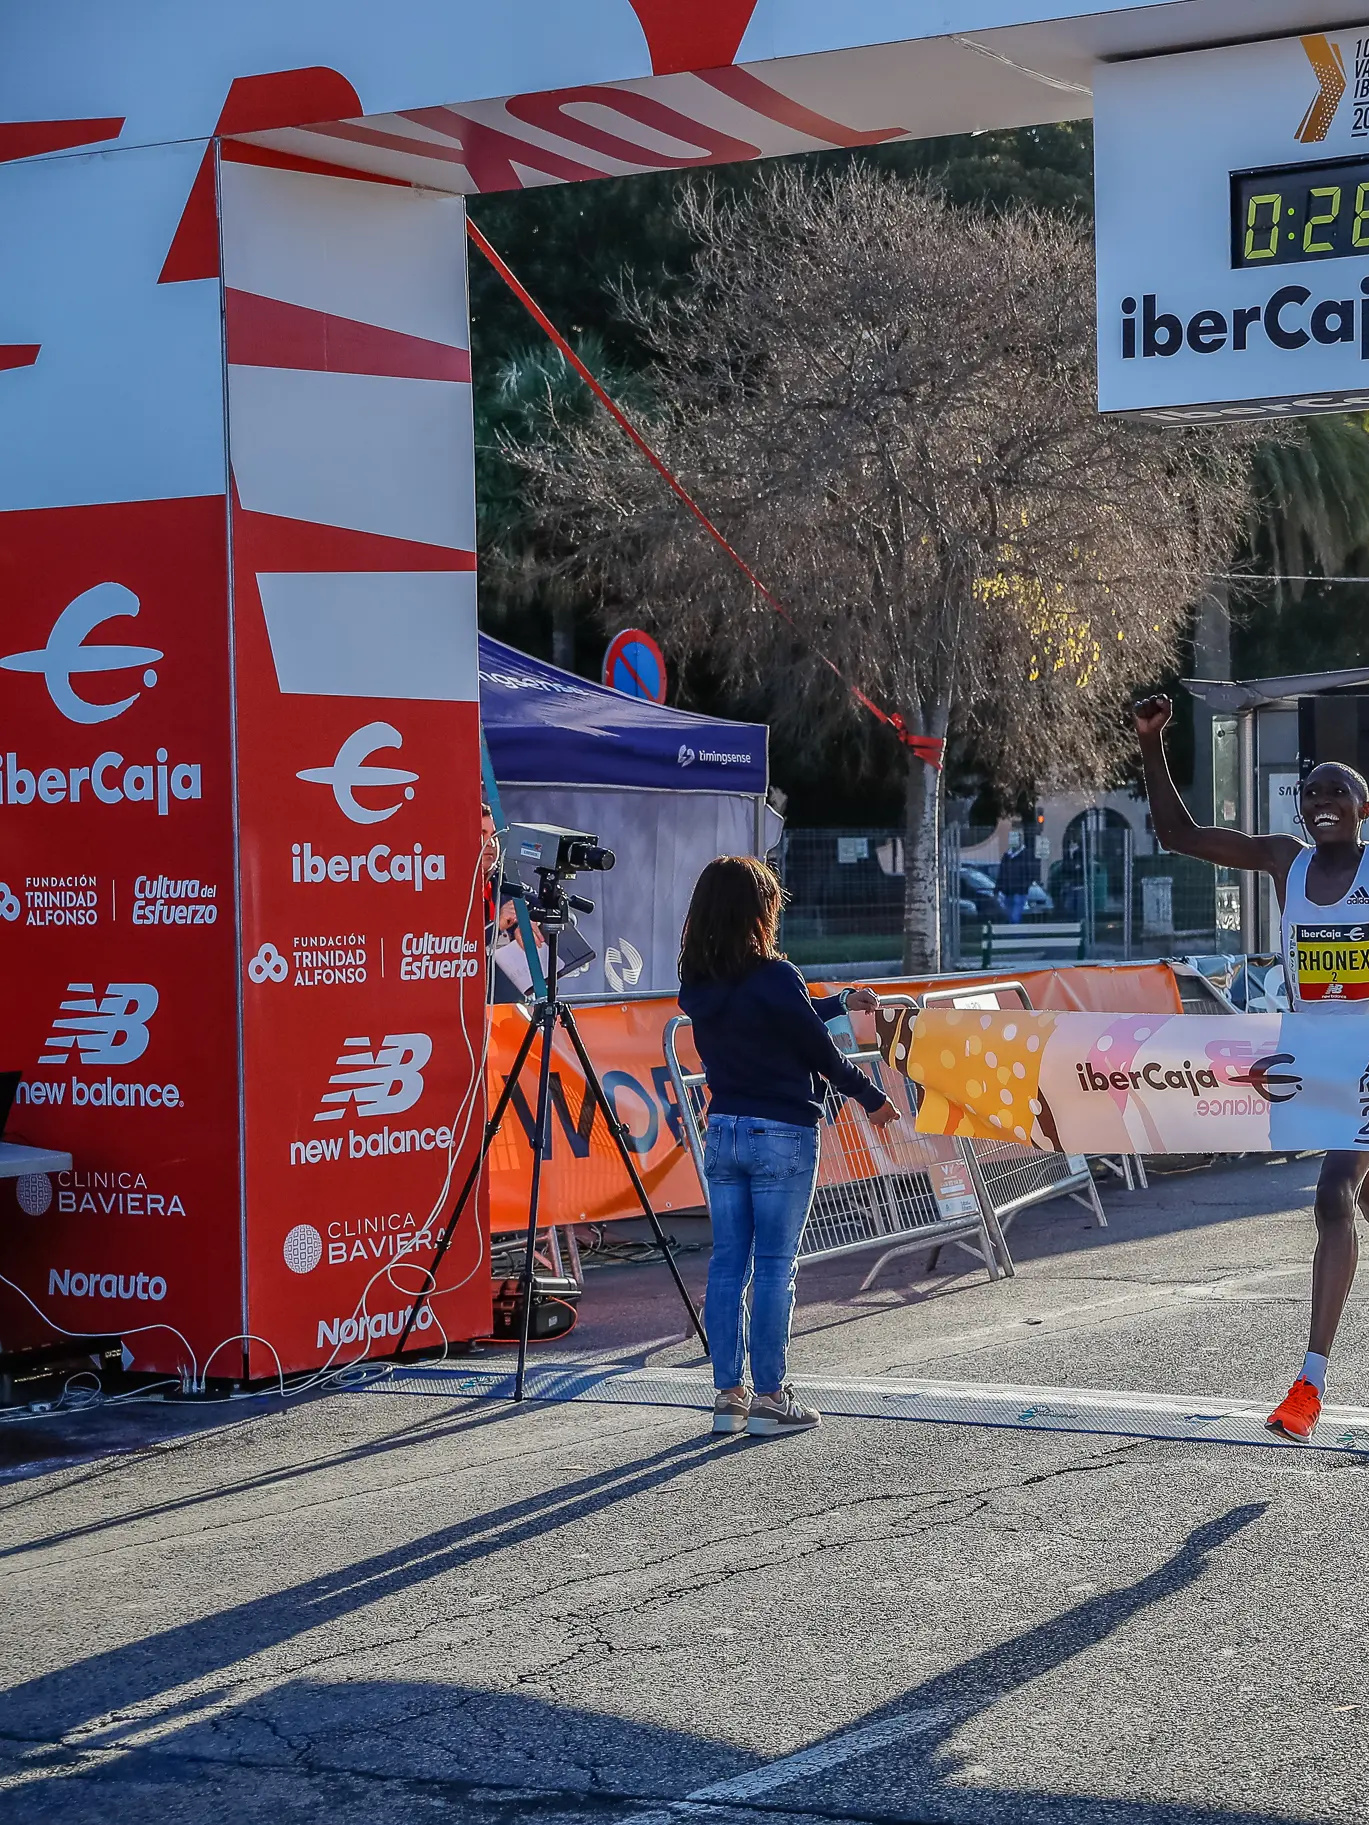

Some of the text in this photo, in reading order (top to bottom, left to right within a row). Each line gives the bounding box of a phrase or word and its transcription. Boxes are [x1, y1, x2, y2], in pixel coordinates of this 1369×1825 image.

[699, 750, 752, 765] timingsense
[0, 747, 202, 816] berCaja
[292, 842, 446, 892] iberCaja
[26, 874, 97, 888] FUNDACIÓN
[134, 874, 217, 899] Cultura del
[25, 891, 98, 908] TRINIDAD
[26, 909, 98, 926] ALFONSO
[132, 899, 218, 925] Esfuerzo
[293, 933, 366, 948] FUNDACIÓN
[401, 932, 478, 955] Cultura del
[1301, 929, 1342, 940] iberCaja
[293, 949, 367, 968] TRINIDAD
[400, 955, 479, 981] Esfuerzo
[294, 967, 367, 986] ALFONSO
[1331, 971, 1338, 982] 2
[1075, 1060, 1220, 1097] iberCaja
[15, 1076, 181, 1108] new balance
[290, 1125, 452, 1166] new balance
[58, 1170, 148, 1189] CLINICA
[58, 1191, 187, 1217] BAVIERA
[327, 1212, 417, 1239] CLINICA
[48, 1268, 168, 1301] Norauto
